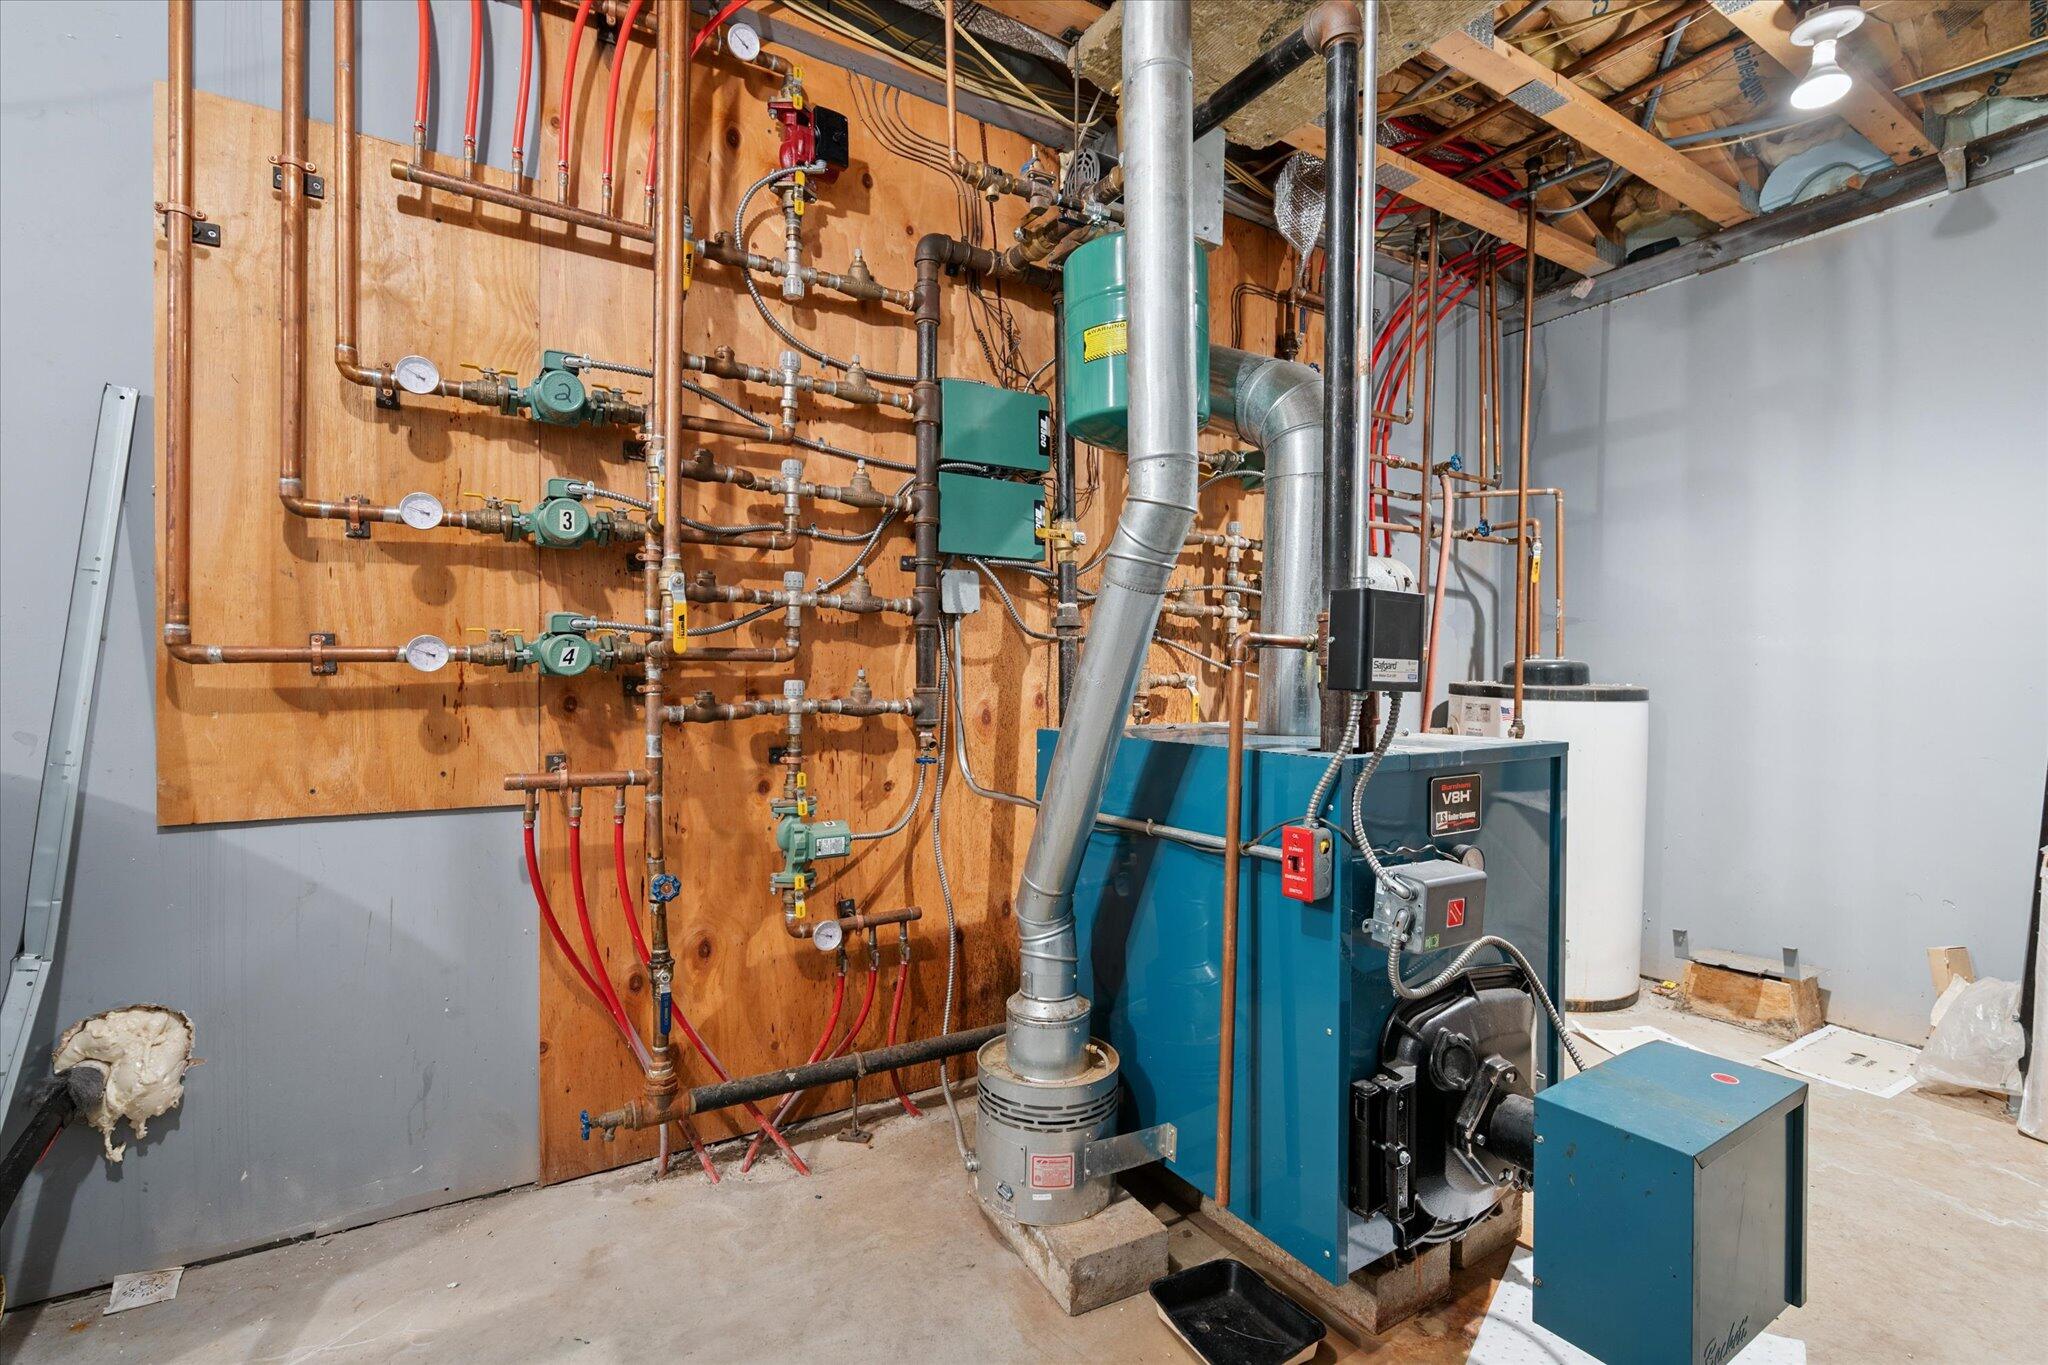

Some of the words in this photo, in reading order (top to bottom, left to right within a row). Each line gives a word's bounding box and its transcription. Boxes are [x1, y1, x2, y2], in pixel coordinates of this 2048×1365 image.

[1091, 323, 1126, 334] WARNING
[555, 383, 572, 403] 2
[563, 511, 573, 531] 3
[562, 648, 575, 665] 4
[1373, 660, 1398, 672] Safgard
